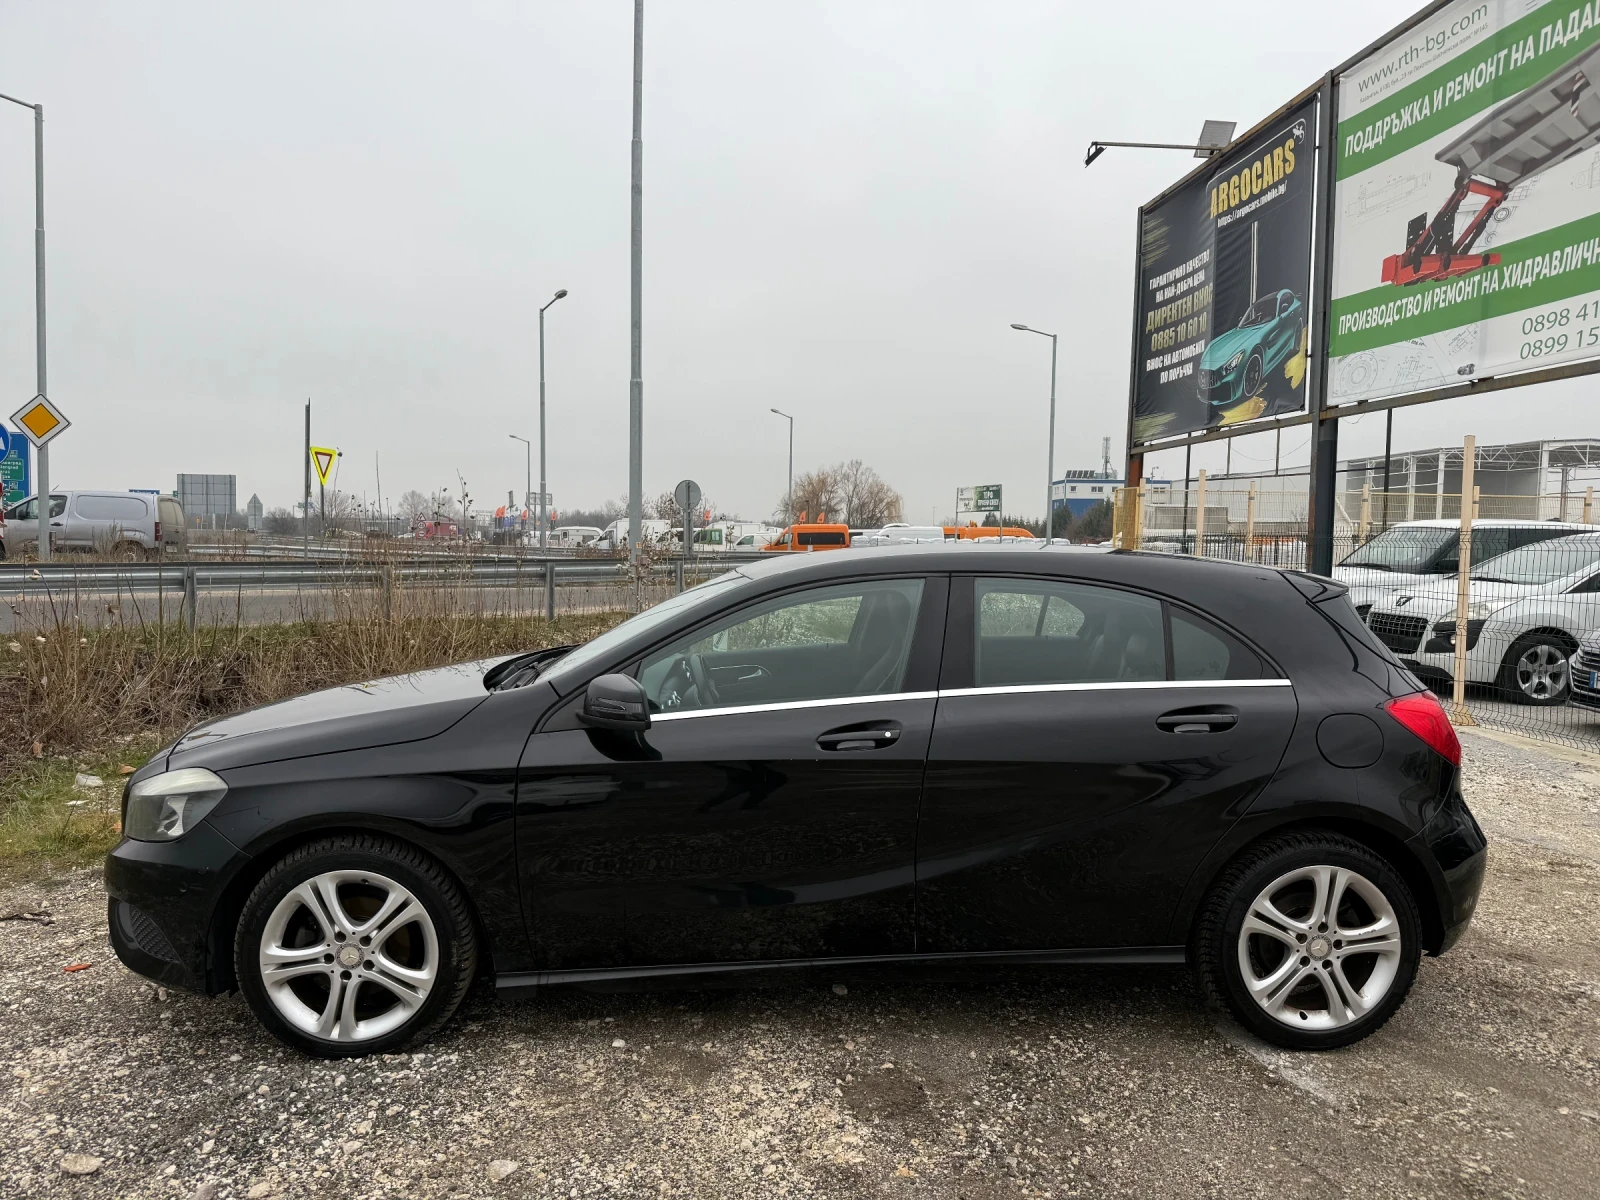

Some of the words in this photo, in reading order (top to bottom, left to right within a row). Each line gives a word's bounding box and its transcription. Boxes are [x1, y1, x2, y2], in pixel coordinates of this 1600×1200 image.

[1358, 4, 1488, 92] www.rth-bg.com
[1344, 95, 1430, 158] ПОДДРЪЖКА
[1432, 89, 1443, 113] И
[1445, 51, 1508, 107] РЕМОНТ
[1509, 37, 1535, 71] НА
[1209, 138, 1296, 220] ARGOCARS
[1217, 179, 1288, 228] https://argocars.mobile.bg/
[1186, 249, 1210, 274] КАЧЕСТВО
[1145, 294, 1193, 335] ДИРЕКТЕН
[1193, 282, 1214, 312] ВНОС
[1338, 293, 1421, 336] ПРОИЗВОДСТВО
[1422, 290, 1432, 313] И
[1432, 272, 1481, 310] РЕМОНТ
[1481, 267, 1499, 296] НА
[1522, 308, 1570, 335] 0898
[1575, 300, 1599, 321] 41
[1151, 326, 1176, 352] 0885
[1176, 322, 1186, 343] 10
[1187, 317, 1198, 339] 60
[1198, 311, 1207, 334] 10
[1520, 333, 1568, 360] 0899
[1576, 326, 1600, 348] 15
[1146, 355, 1163, 372] ВНОС
[1163, 353, 1172, 367] НА
[1160, 370, 1168, 384] ПО
